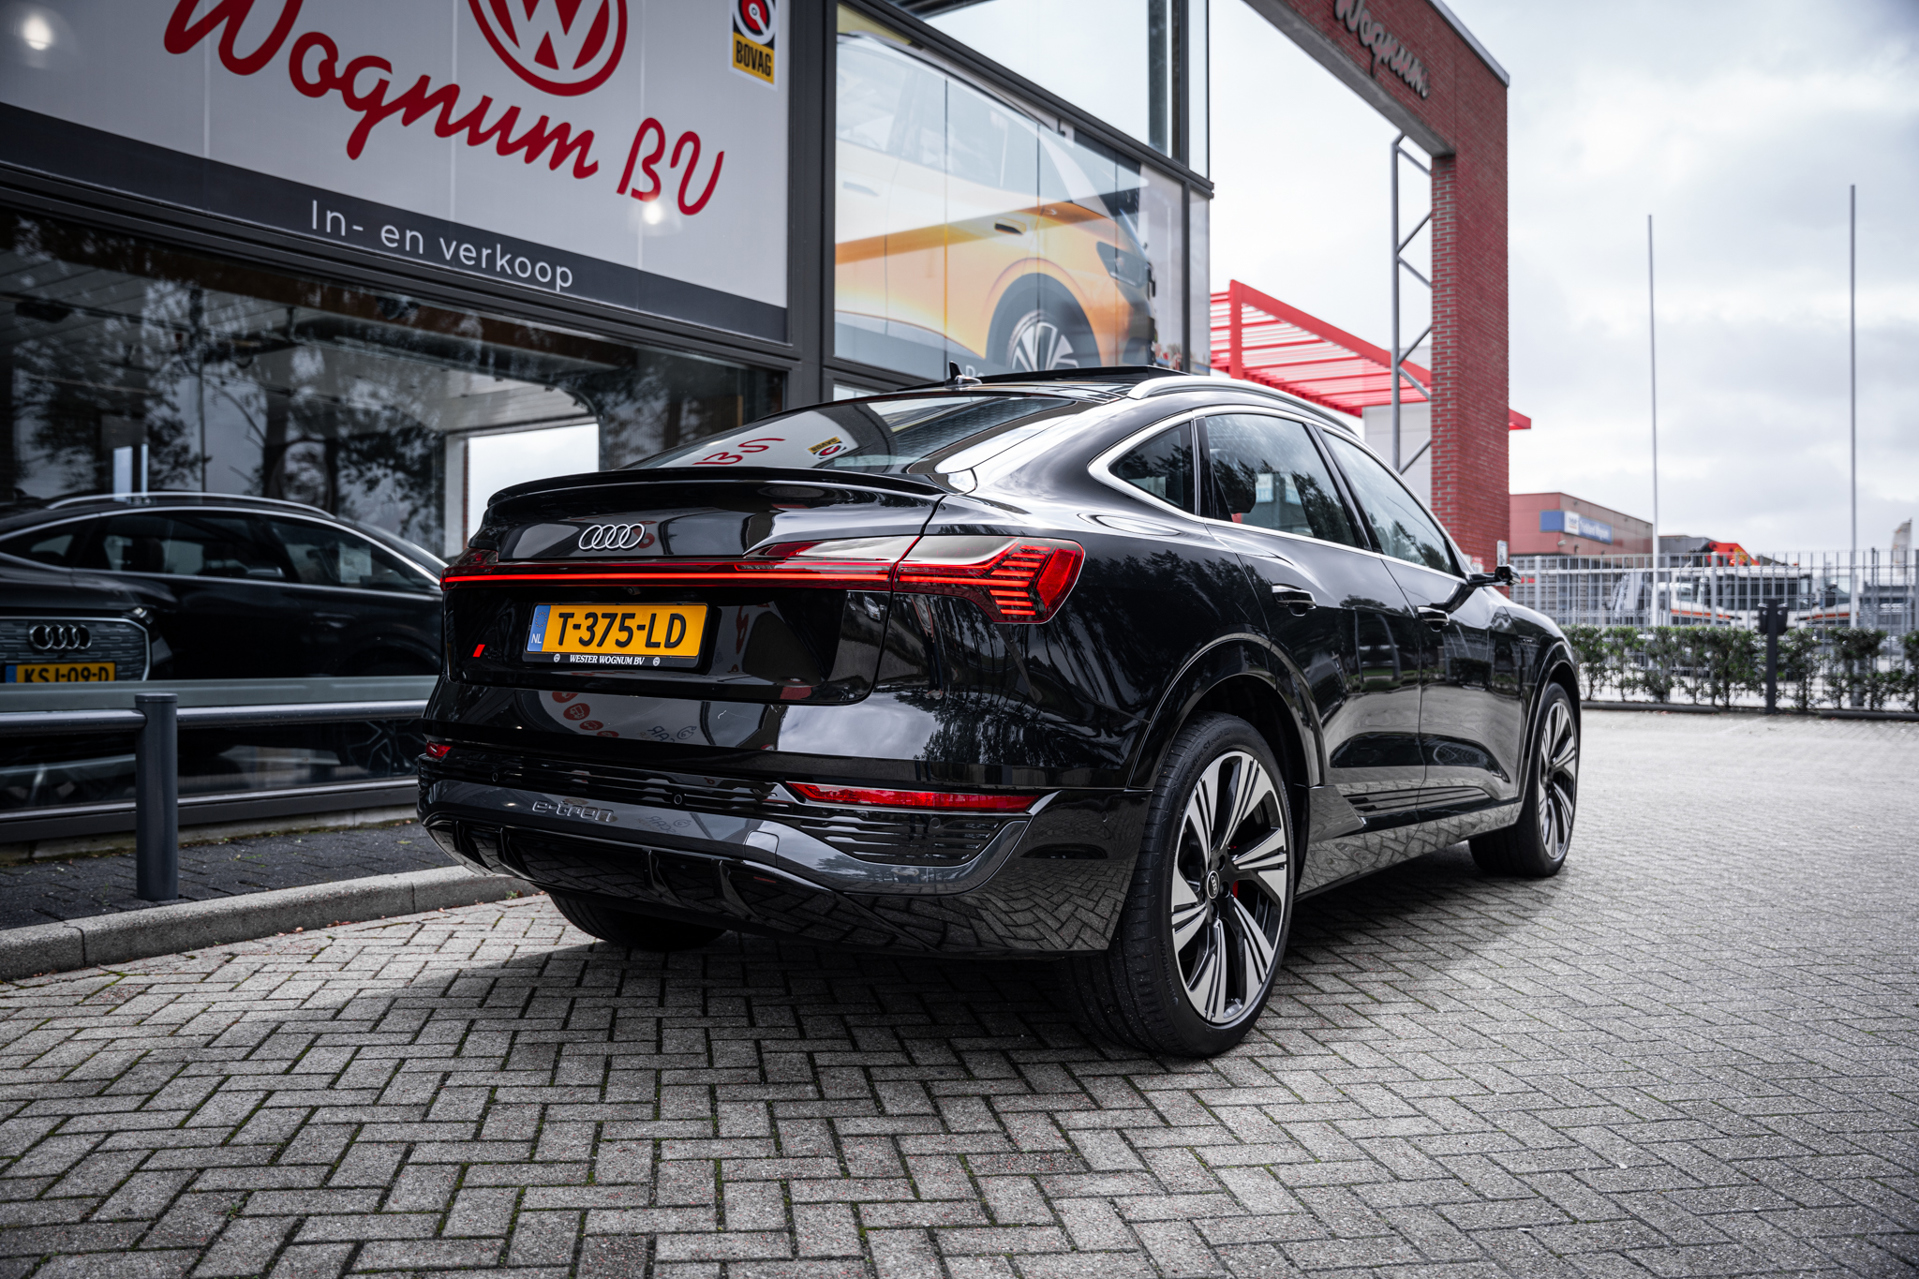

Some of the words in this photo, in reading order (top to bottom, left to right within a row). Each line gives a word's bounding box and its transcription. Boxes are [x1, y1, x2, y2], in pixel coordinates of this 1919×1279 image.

[736, 39, 772, 77] BOVAG
[312, 200, 364, 236] In-
[380, 223, 424, 254] en
[439, 236, 573, 292] verkoop
[531, 633, 542, 644] NL
[558, 612, 687, 649] T-375-LD
[569, 654, 598, 663] WESTER
[599, 655, 633, 665] WOGNUM
[633, 657, 645, 665] BV
[532, 800, 614, 823] e-tron
